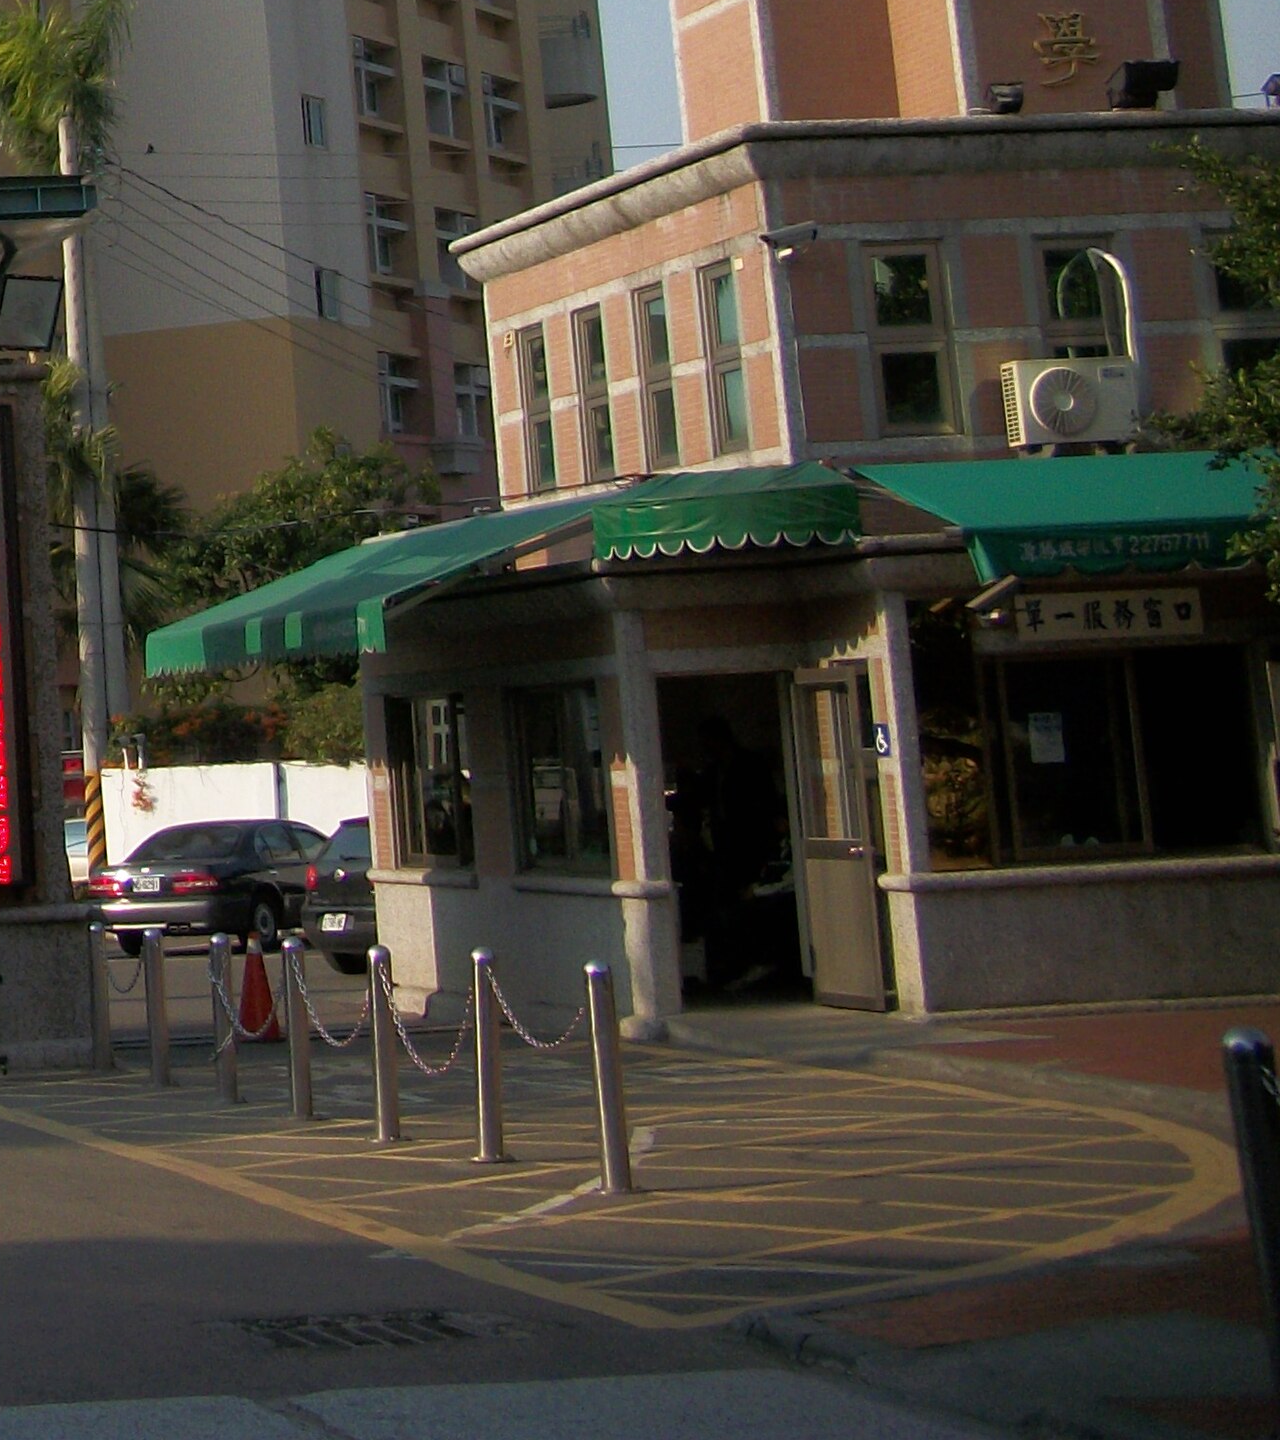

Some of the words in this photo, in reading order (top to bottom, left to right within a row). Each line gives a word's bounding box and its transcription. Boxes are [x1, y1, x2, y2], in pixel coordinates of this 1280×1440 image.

[1024, 597, 1193, 633] 單一服務窗口
